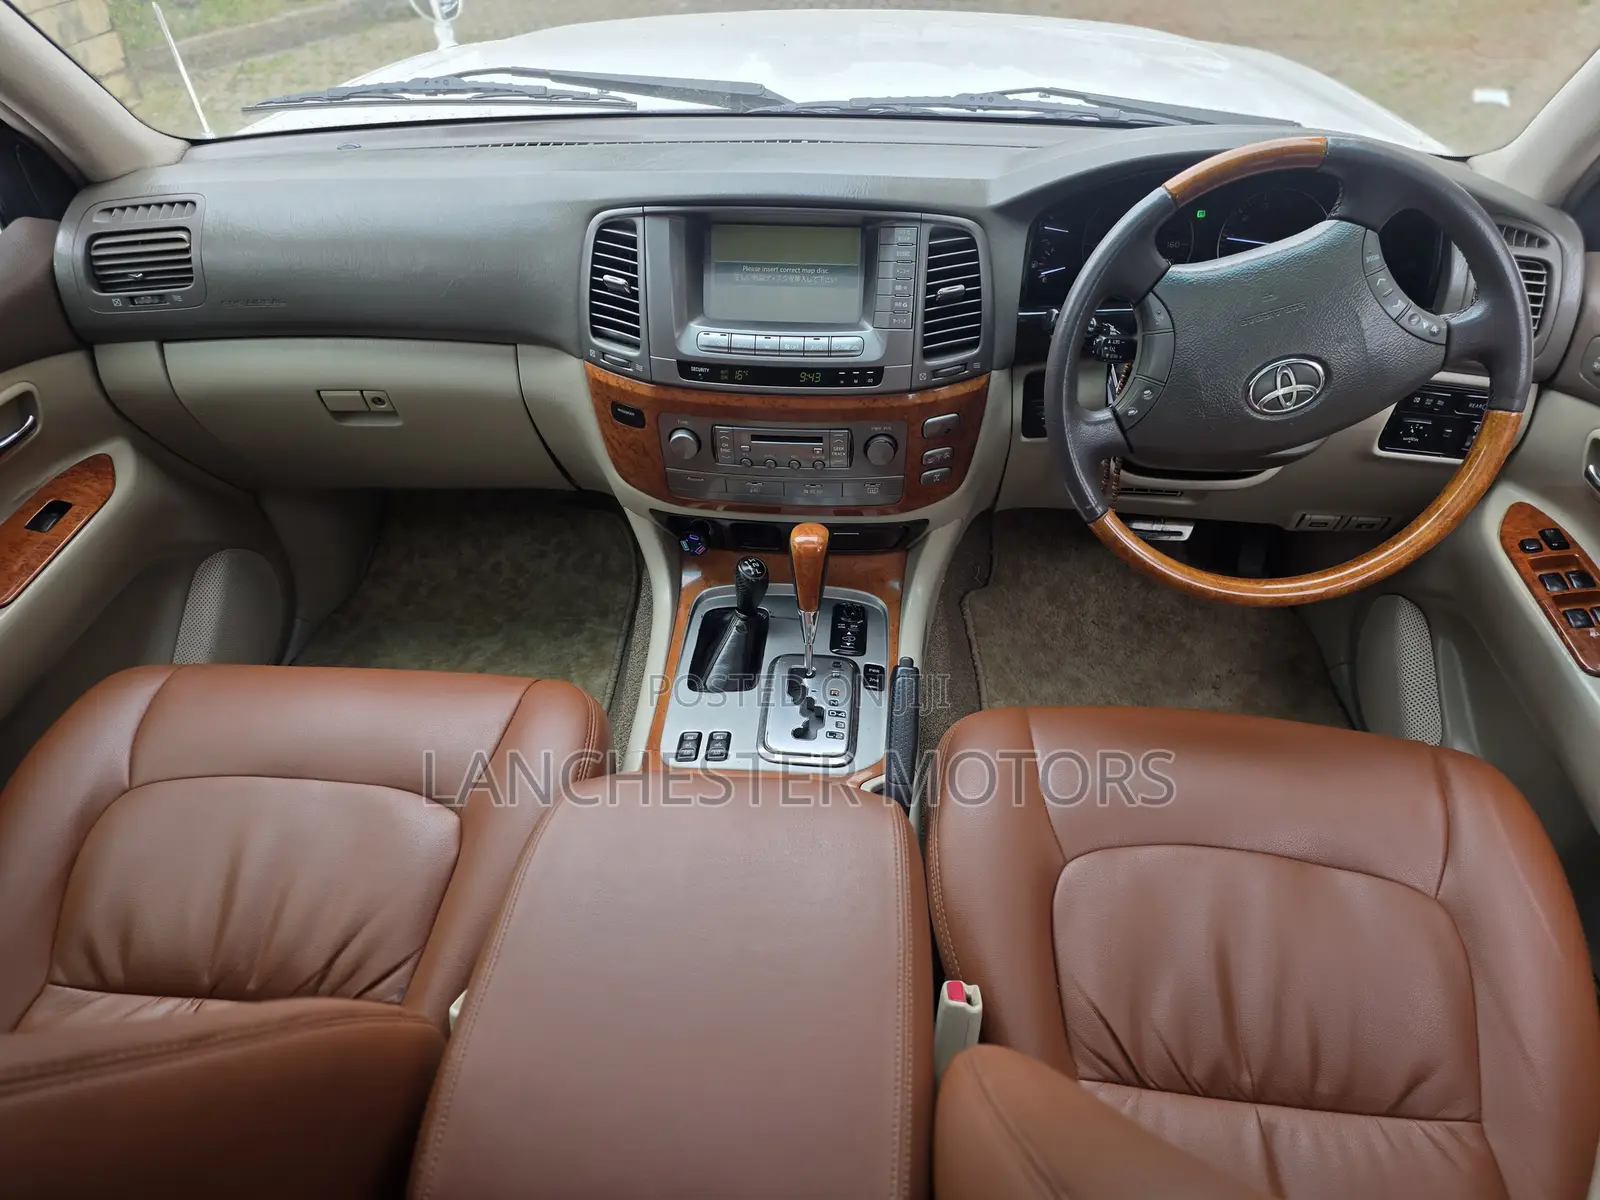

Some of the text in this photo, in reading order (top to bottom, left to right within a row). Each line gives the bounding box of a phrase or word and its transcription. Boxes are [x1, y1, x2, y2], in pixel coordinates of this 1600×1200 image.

[742, 265, 761, 273] Please
[762, 266, 779, 274] insert
[799, 371, 822, 383] 9:43
